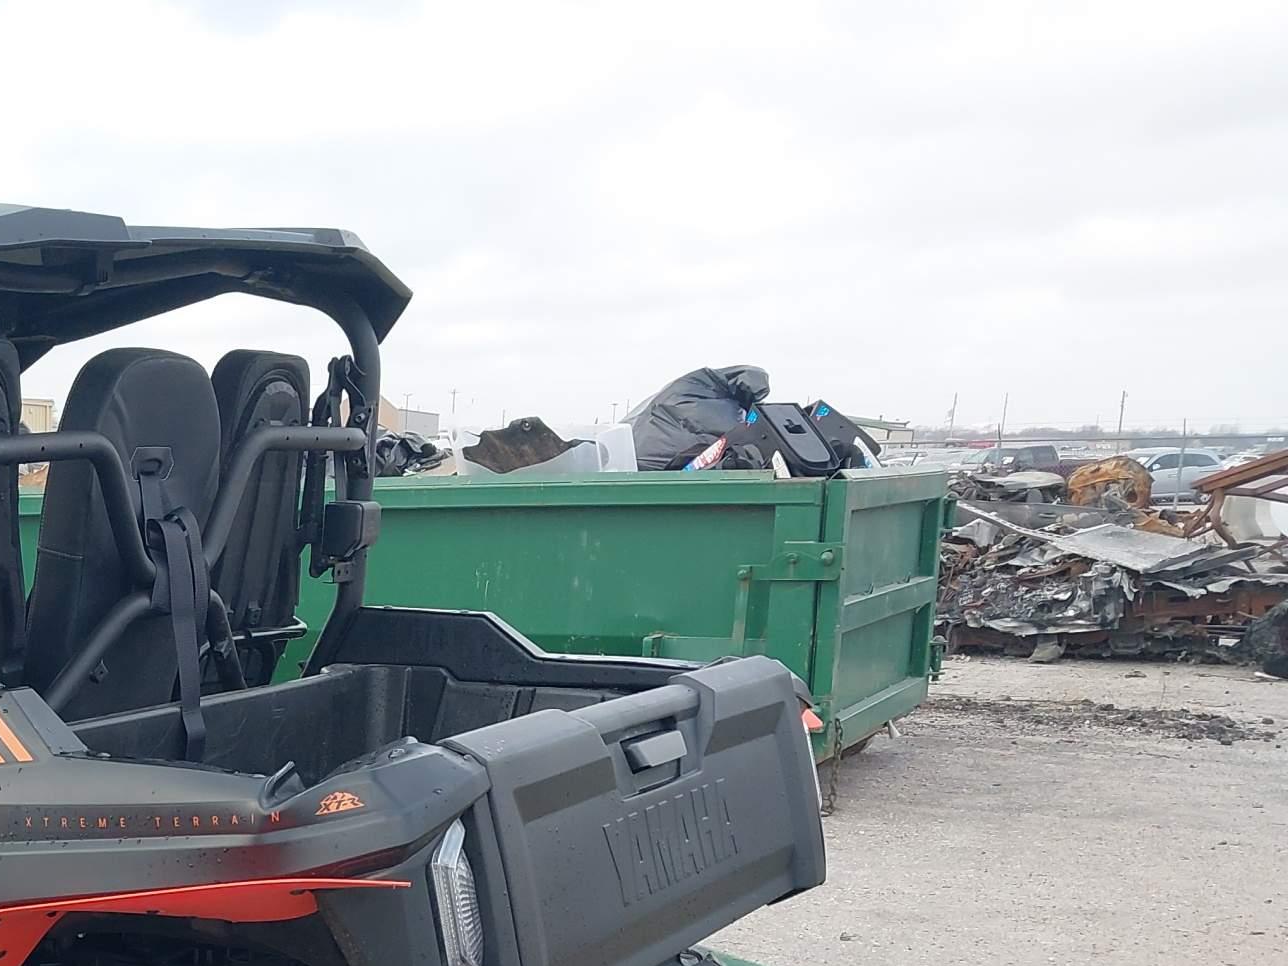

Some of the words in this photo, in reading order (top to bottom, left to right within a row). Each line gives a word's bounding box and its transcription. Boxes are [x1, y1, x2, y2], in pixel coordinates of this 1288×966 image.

[24, 815, 128, 829] XTREME
[153, 811, 281, 829] TERRAIN
[601, 778, 739, 908] YAMAHA
